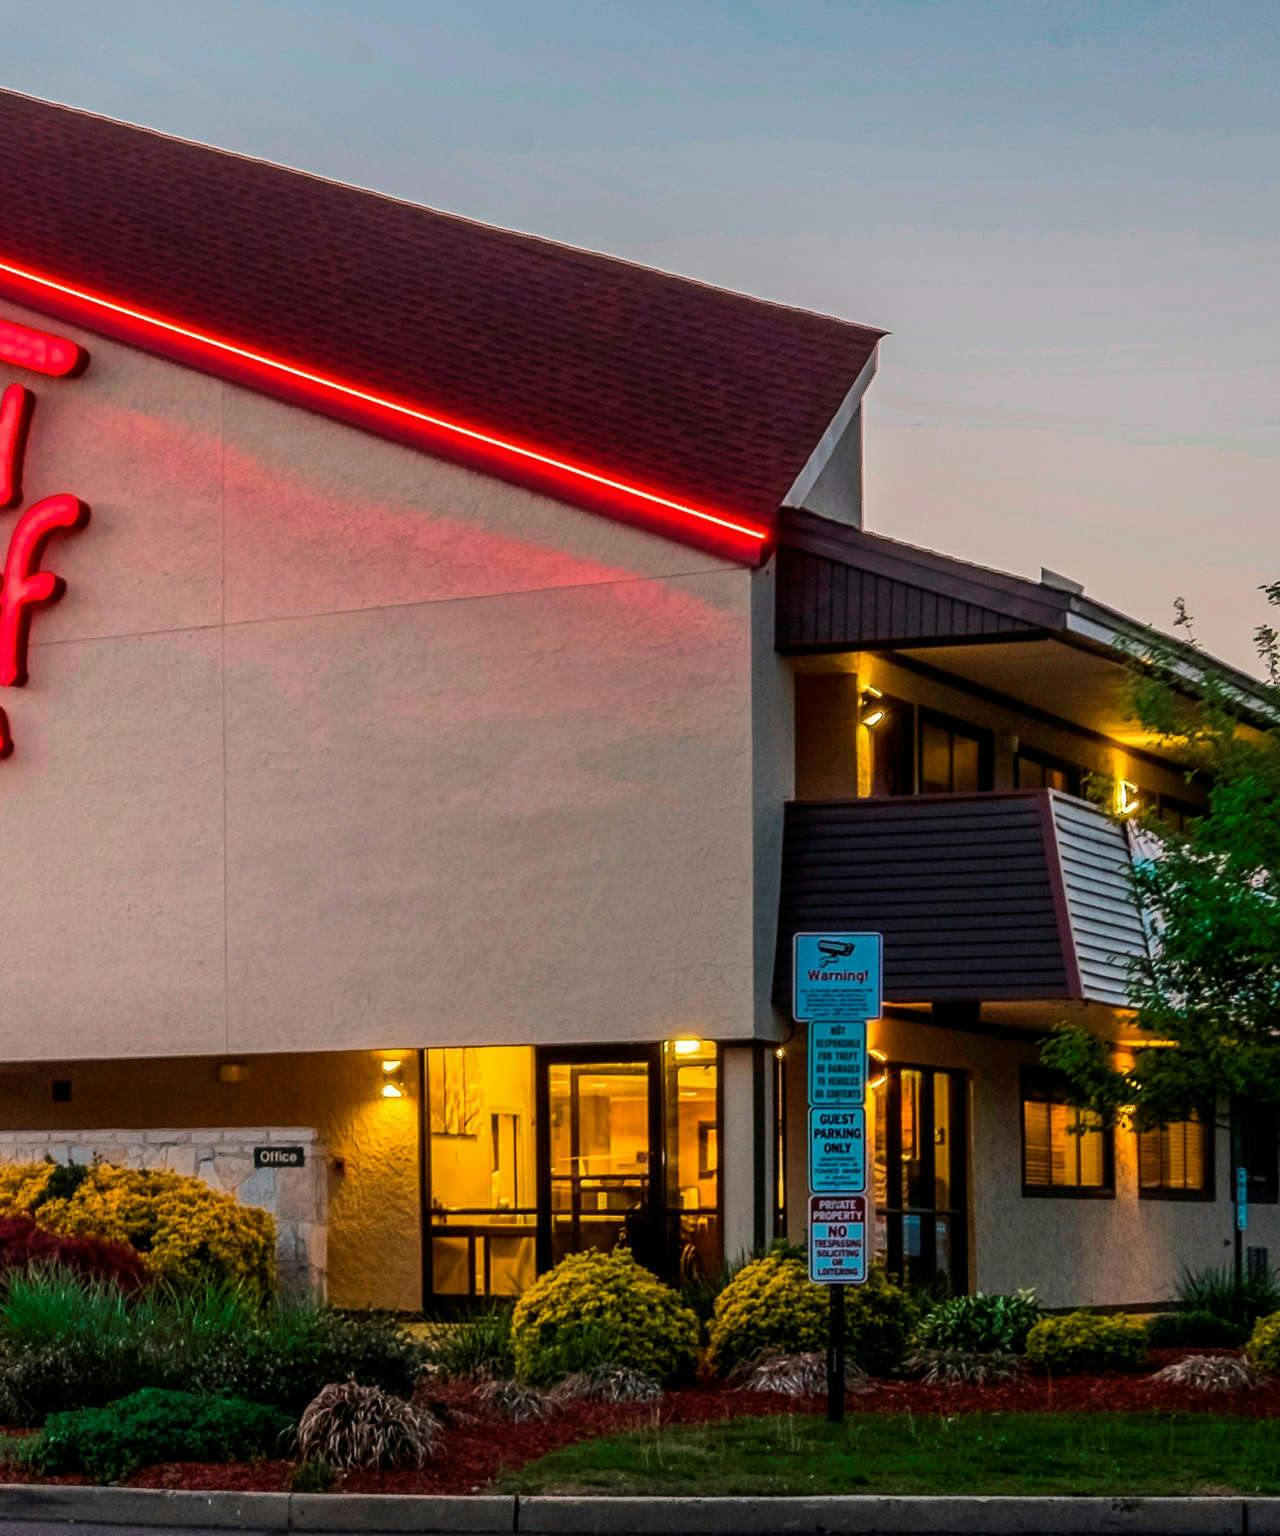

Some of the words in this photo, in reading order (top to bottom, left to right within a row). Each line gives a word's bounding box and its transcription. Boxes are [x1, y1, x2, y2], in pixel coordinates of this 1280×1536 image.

[807, 969, 869, 984] Warning!
[831, 1025, 846, 1035] NOT
[816, 1039, 861, 1048] RESPONSIBLE
[818, 1051, 832, 1061] FOR
[835, 1051, 857, 1061] THEFT
[817, 1076, 826, 1086] TO
[828, 1076, 860, 1086] VEHICLES
[827, 1089, 861, 1099] CONTENTS
[819, 1113, 855, 1125] GUEST
[814, 1128, 861, 1139] PARKING
[823, 1142, 851, 1153] ONLY
[260, 1150, 298, 1162] Office
[819, 1200, 857, 1210] PRIVATE
[813, 1211, 863, 1221] PROPERTY
[828, 1225, 848, 1238] NO
[815, 1240, 862, 1248] TRESPASSING
[816, 1249, 860, 1258] SOLICITING
[817, 1268, 859, 1277] LOITERING
